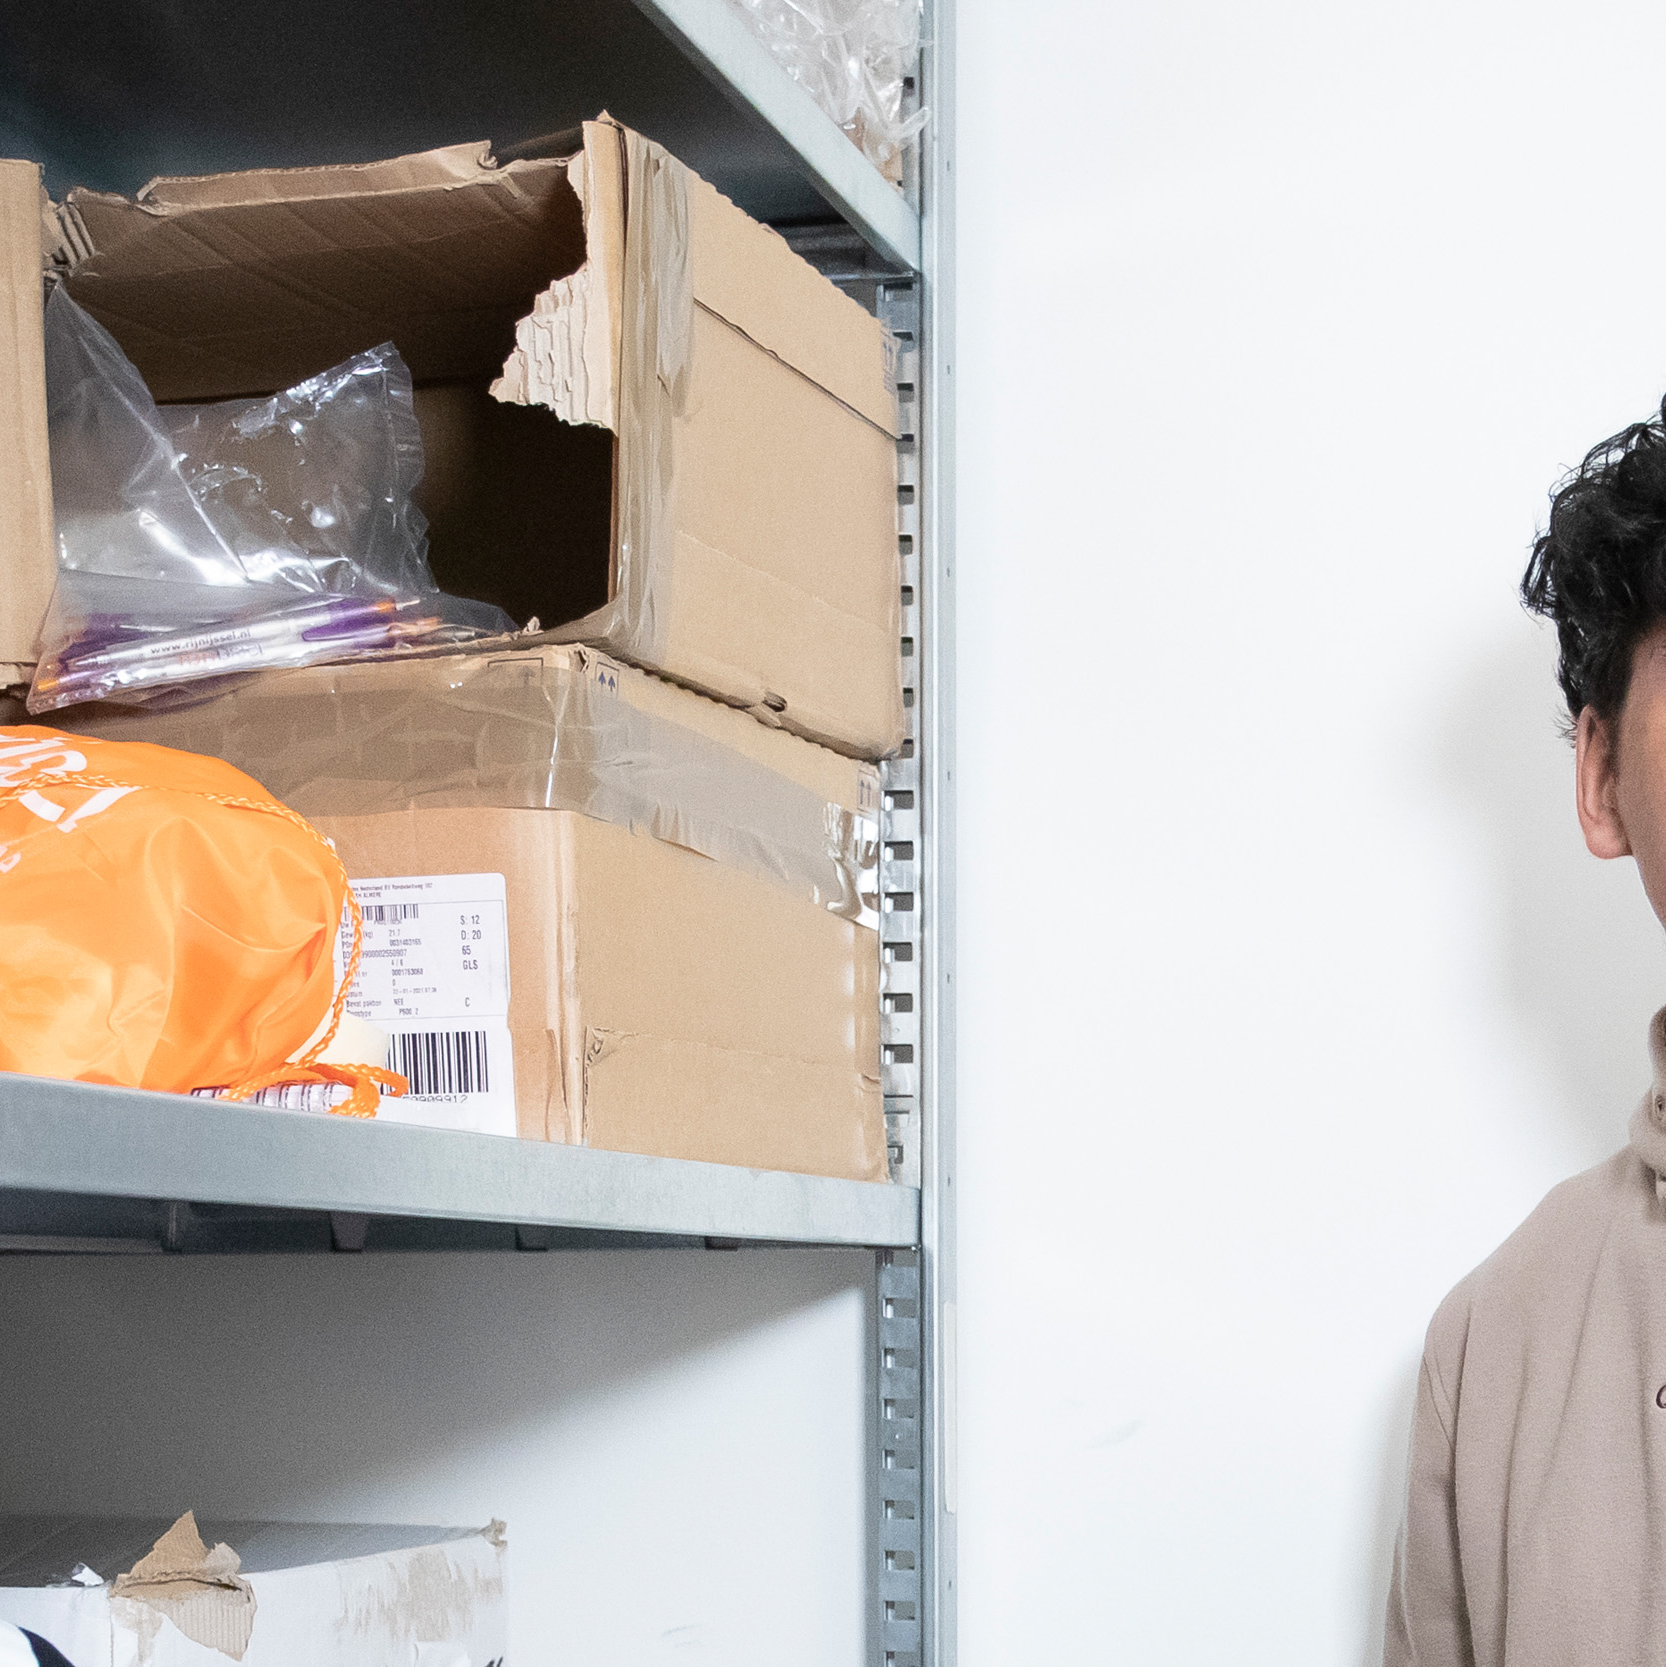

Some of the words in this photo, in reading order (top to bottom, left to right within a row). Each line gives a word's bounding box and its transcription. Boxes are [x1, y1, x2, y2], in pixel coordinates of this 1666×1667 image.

[150, 630, 252, 654] www.rijnijssel.nl
[471, 914, 480, 925] 12
[472, 929, 482, 940] 20
[463, 959, 479, 970] GLS
